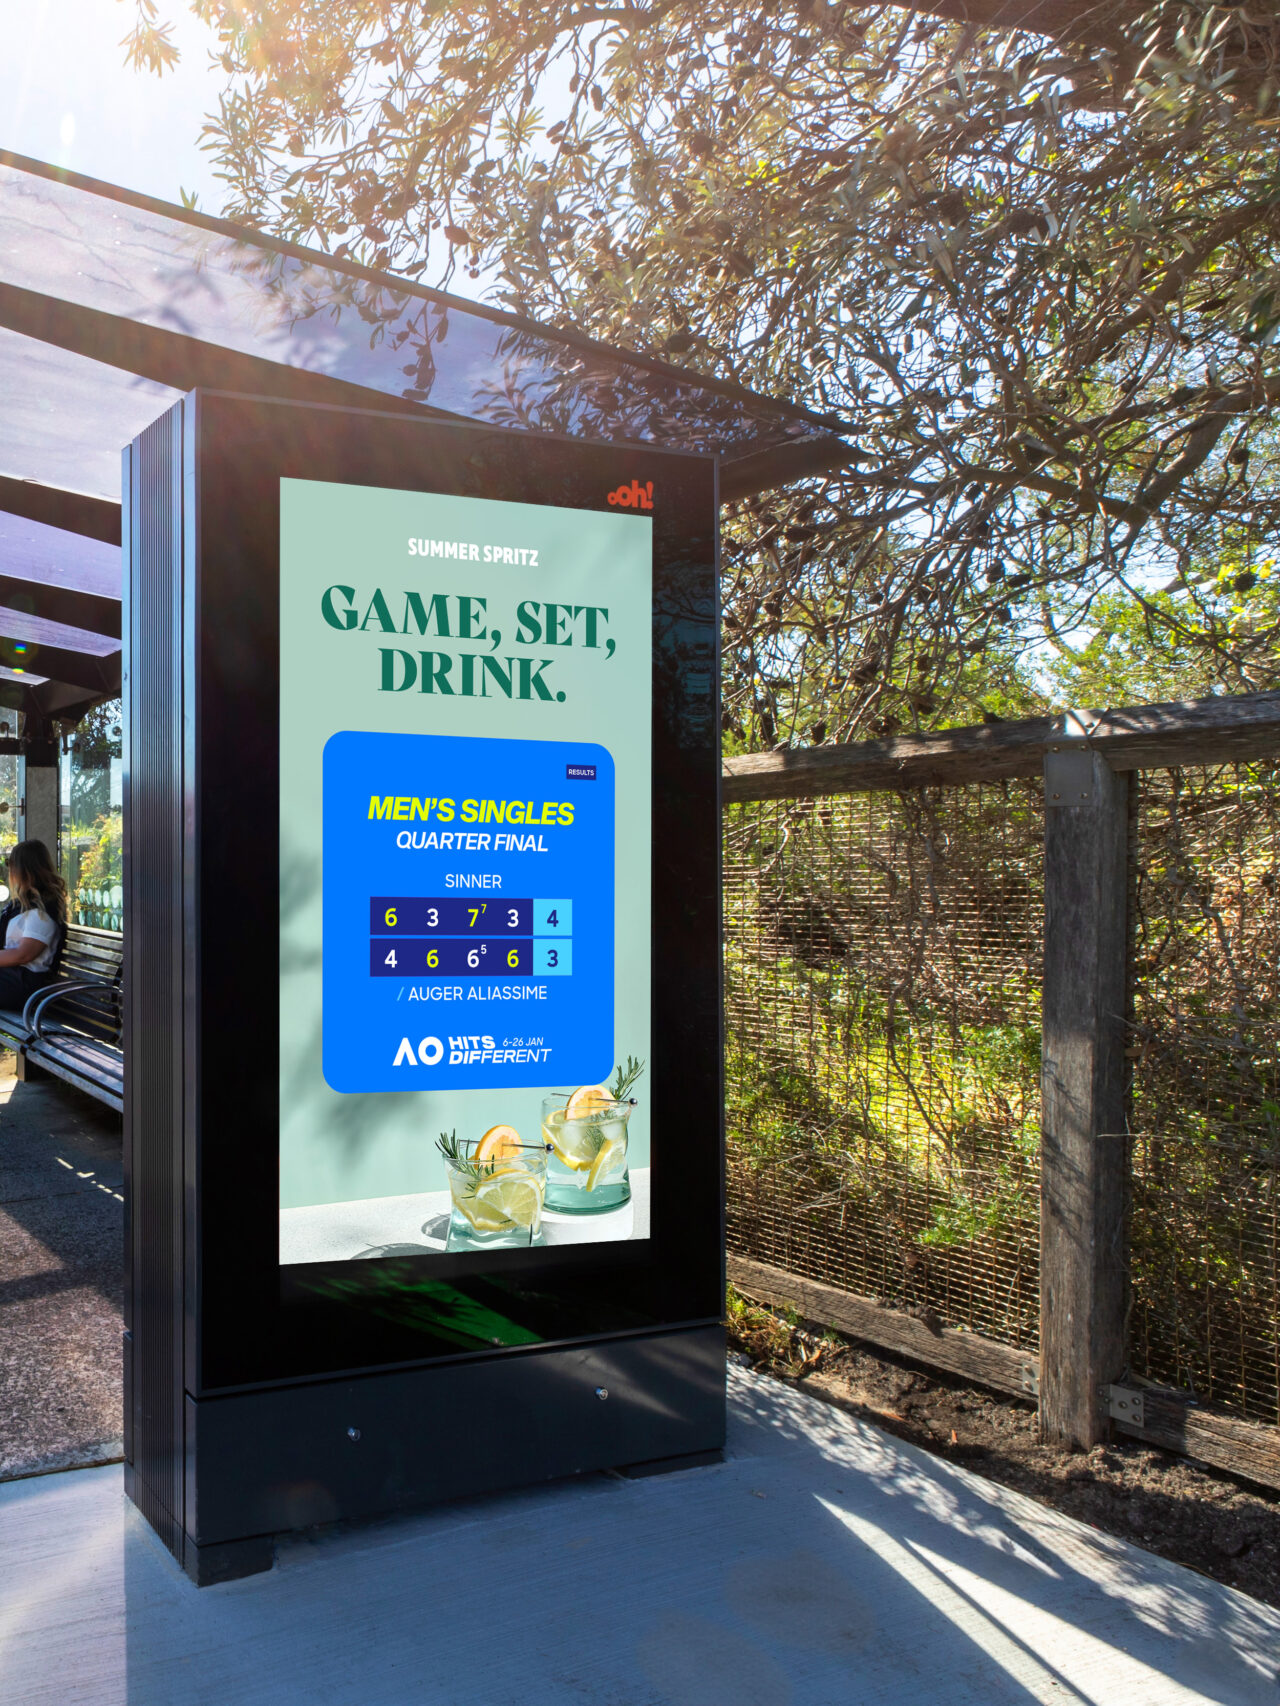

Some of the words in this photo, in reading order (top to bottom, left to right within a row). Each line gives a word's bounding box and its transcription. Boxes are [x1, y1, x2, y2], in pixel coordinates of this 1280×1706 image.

[408, 538, 480, 561] SUMMER
[484, 545, 538, 566] SPRITZ
[321, 585, 501, 651] GAME,
[515, 601, 616, 660] SET,
[378, 648, 566, 703] DRINK.
[568, 768, 595, 776] RESULTS
[368, 796, 455, 822] MEN’S
[460, 799, 574, 825] SINGLES
[397, 831, 491, 850] QUARTER
[494, 834, 548, 851] FINAL
[446, 874, 501, 888] SINNER
[385, 908, 397, 926] 6
[427, 908, 438, 926] 3
[507, 909, 519, 927] 3
[547, 910, 558, 927] 4
[385, 950, 397, 968] 4
[427, 950, 438, 968] 6
[507, 950, 519, 967] 6
[547, 950, 558, 967] 3
[408, 987, 463, 1001] AUGER
[467, 986, 547, 1000] ALIASSIME
[448, 1036, 496, 1049] HITS
[503, 1037, 524, 1047] 6-26
[525, 1037, 544, 1046] JAN
[449, 1049, 552, 1065] DIFFERENT
